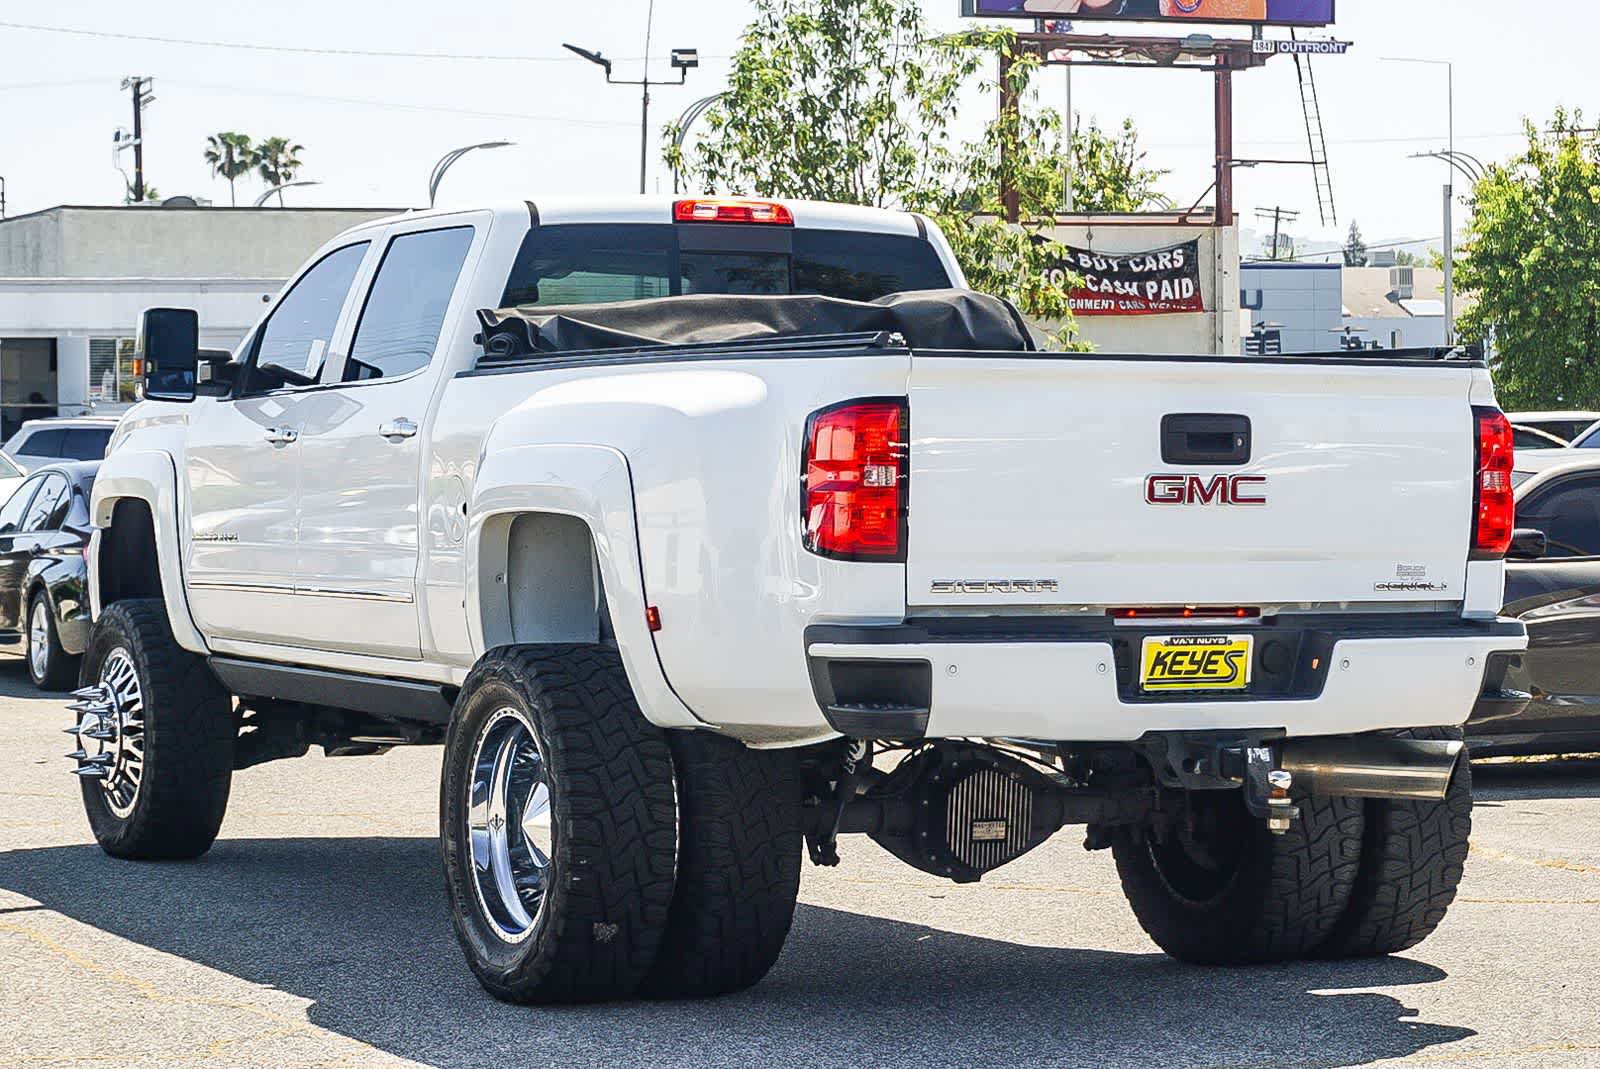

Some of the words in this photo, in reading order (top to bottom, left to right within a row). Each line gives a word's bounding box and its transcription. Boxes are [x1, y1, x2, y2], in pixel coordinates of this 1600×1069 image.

[1280, 42, 1346, 54] OUTFRONT
[1078, 253, 1120, 272] BUY
[1128, 249, 1184, 273] CARS
[1086, 274, 1139, 297] CASH
[1146, 278, 1194, 300] PAID
[1144, 473, 1267, 505] GMC
[931, 579, 1058, 593] SIERRA
[1149, 650, 1245, 684] KEYES
